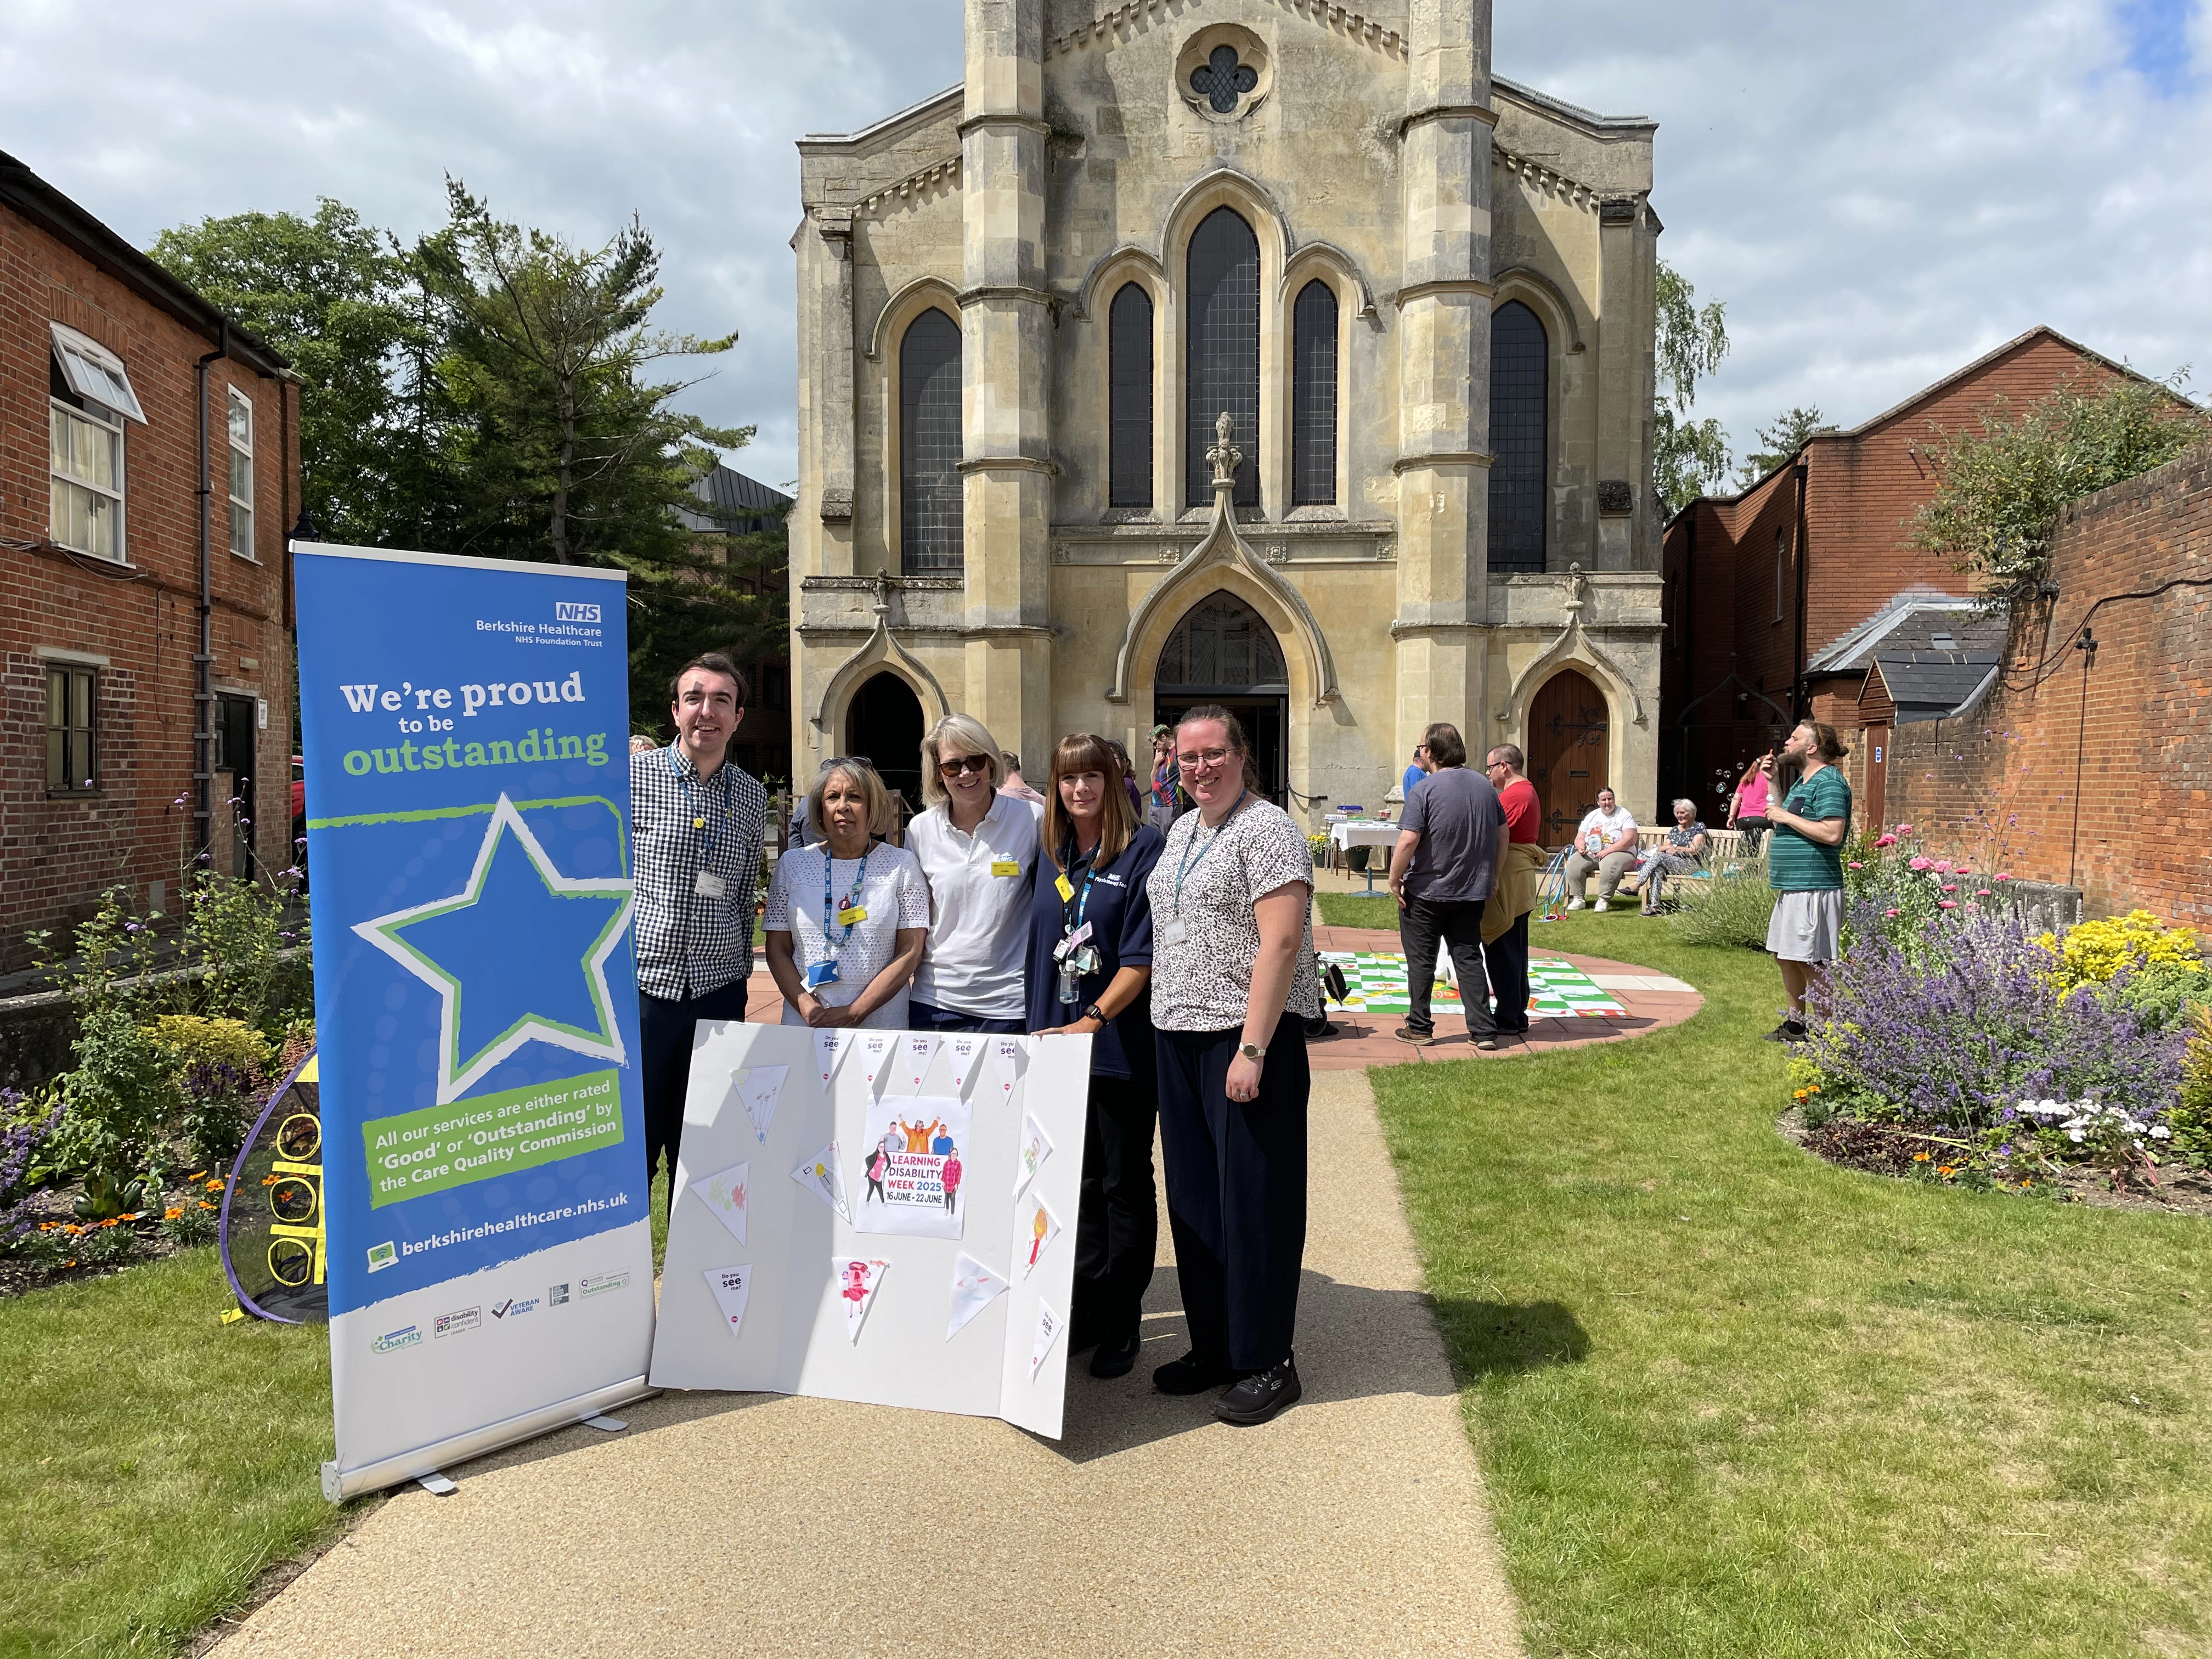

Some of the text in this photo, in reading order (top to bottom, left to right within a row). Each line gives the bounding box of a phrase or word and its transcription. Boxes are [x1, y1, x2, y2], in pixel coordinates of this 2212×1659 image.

[558, 604, 599, 621] NHS
[476, 619, 602, 637] Berkshire Healthcare
[515, 635, 603, 648] NHS Foundation Trust
[340, 671, 586, 717] We're proud
[398, 714, 454, 734] to be
[343, 727, 609, 776] outstanding
[1094, 876, 1119, 887] Physiotherapy
[375, 1080, 611, 1150] All our services are either rated
[446, 1139, 463, 1153] or
[595, 1102, 613, 1119] by
[379, 1120, 617, 1193] the Care Quality Commission
[892, 1155, 941, 1167] LEARNING
[889, 1167, 943, 1180] DISABILITY
[888, 1179, 941, 1192] WEEK 2025
[886, 1191, 894, 1200] 16
[894, 1192, 911, 1201] JUNE
[916, 1193, 924, 1203] 22
[924, 1194, 943, 1204] JUNE
[402, 1192, 628, 1256] berkshirehealthcare.nhs.uk
[583, 1280, 621, 1295] Outstanding
[722, 1277, 741, 1288] see
[510, 1298, 540, 1311] VETERAN
[510, 1305, 534, 1317] AWARE
[451, 1308, 479, 1322] disability
[451, 1316, 479, 1329] confident
[1042, 1318, 1052, 1333] see
[379, 1330, 422, 1351] Charity
